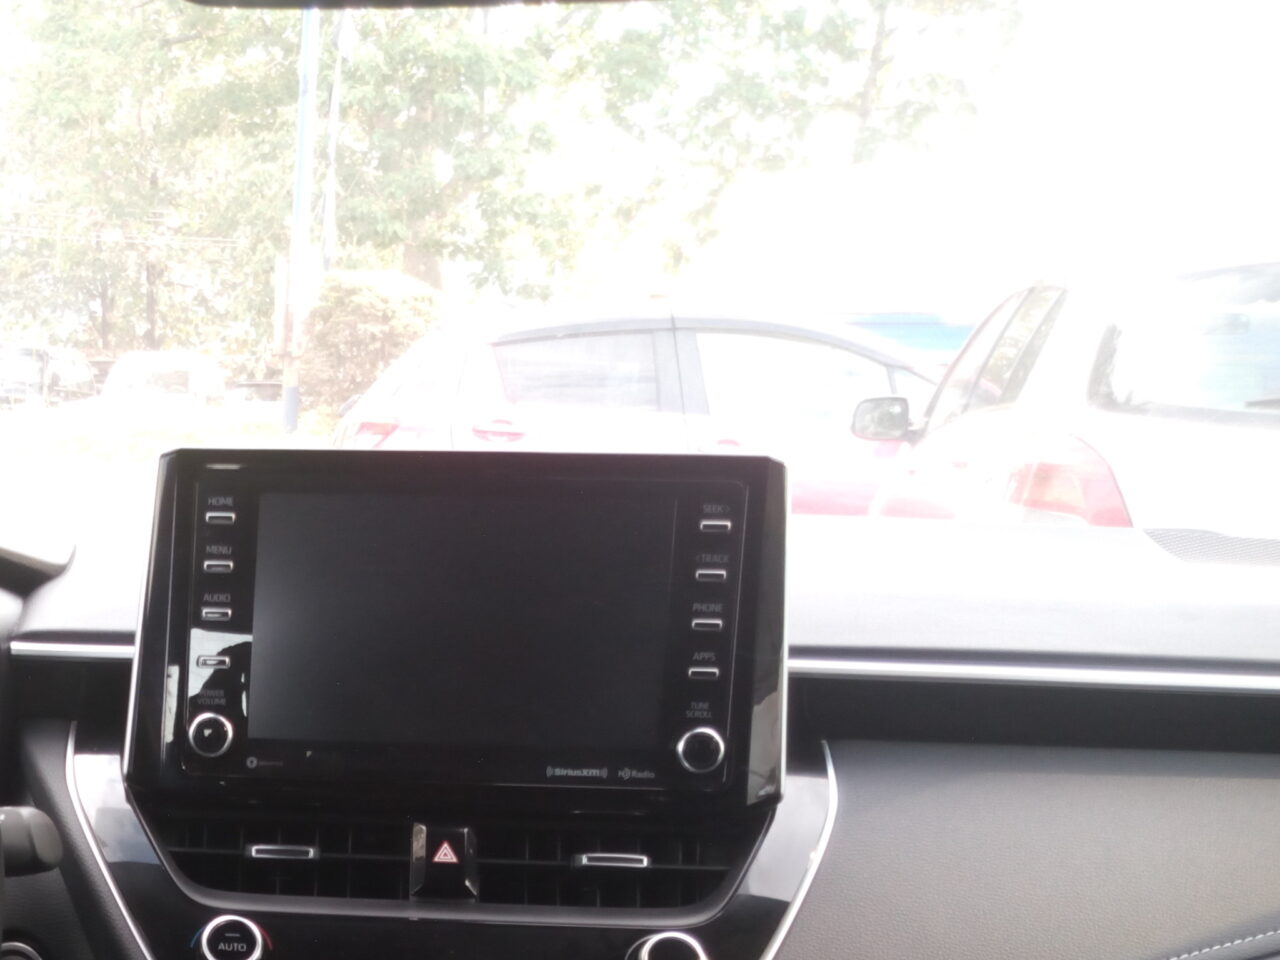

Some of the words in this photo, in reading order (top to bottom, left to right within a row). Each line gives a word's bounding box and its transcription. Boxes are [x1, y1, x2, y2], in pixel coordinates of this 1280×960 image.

[208, 497, 234, 506] HOME
[206, 545, 232, 555] MENU
[203, 593, 231, 602] AUDIO
[693, 603, 723, 613] PHONE
[692, 652, 716, 661] APPS
[218, 941, 247, 952] AUTO
